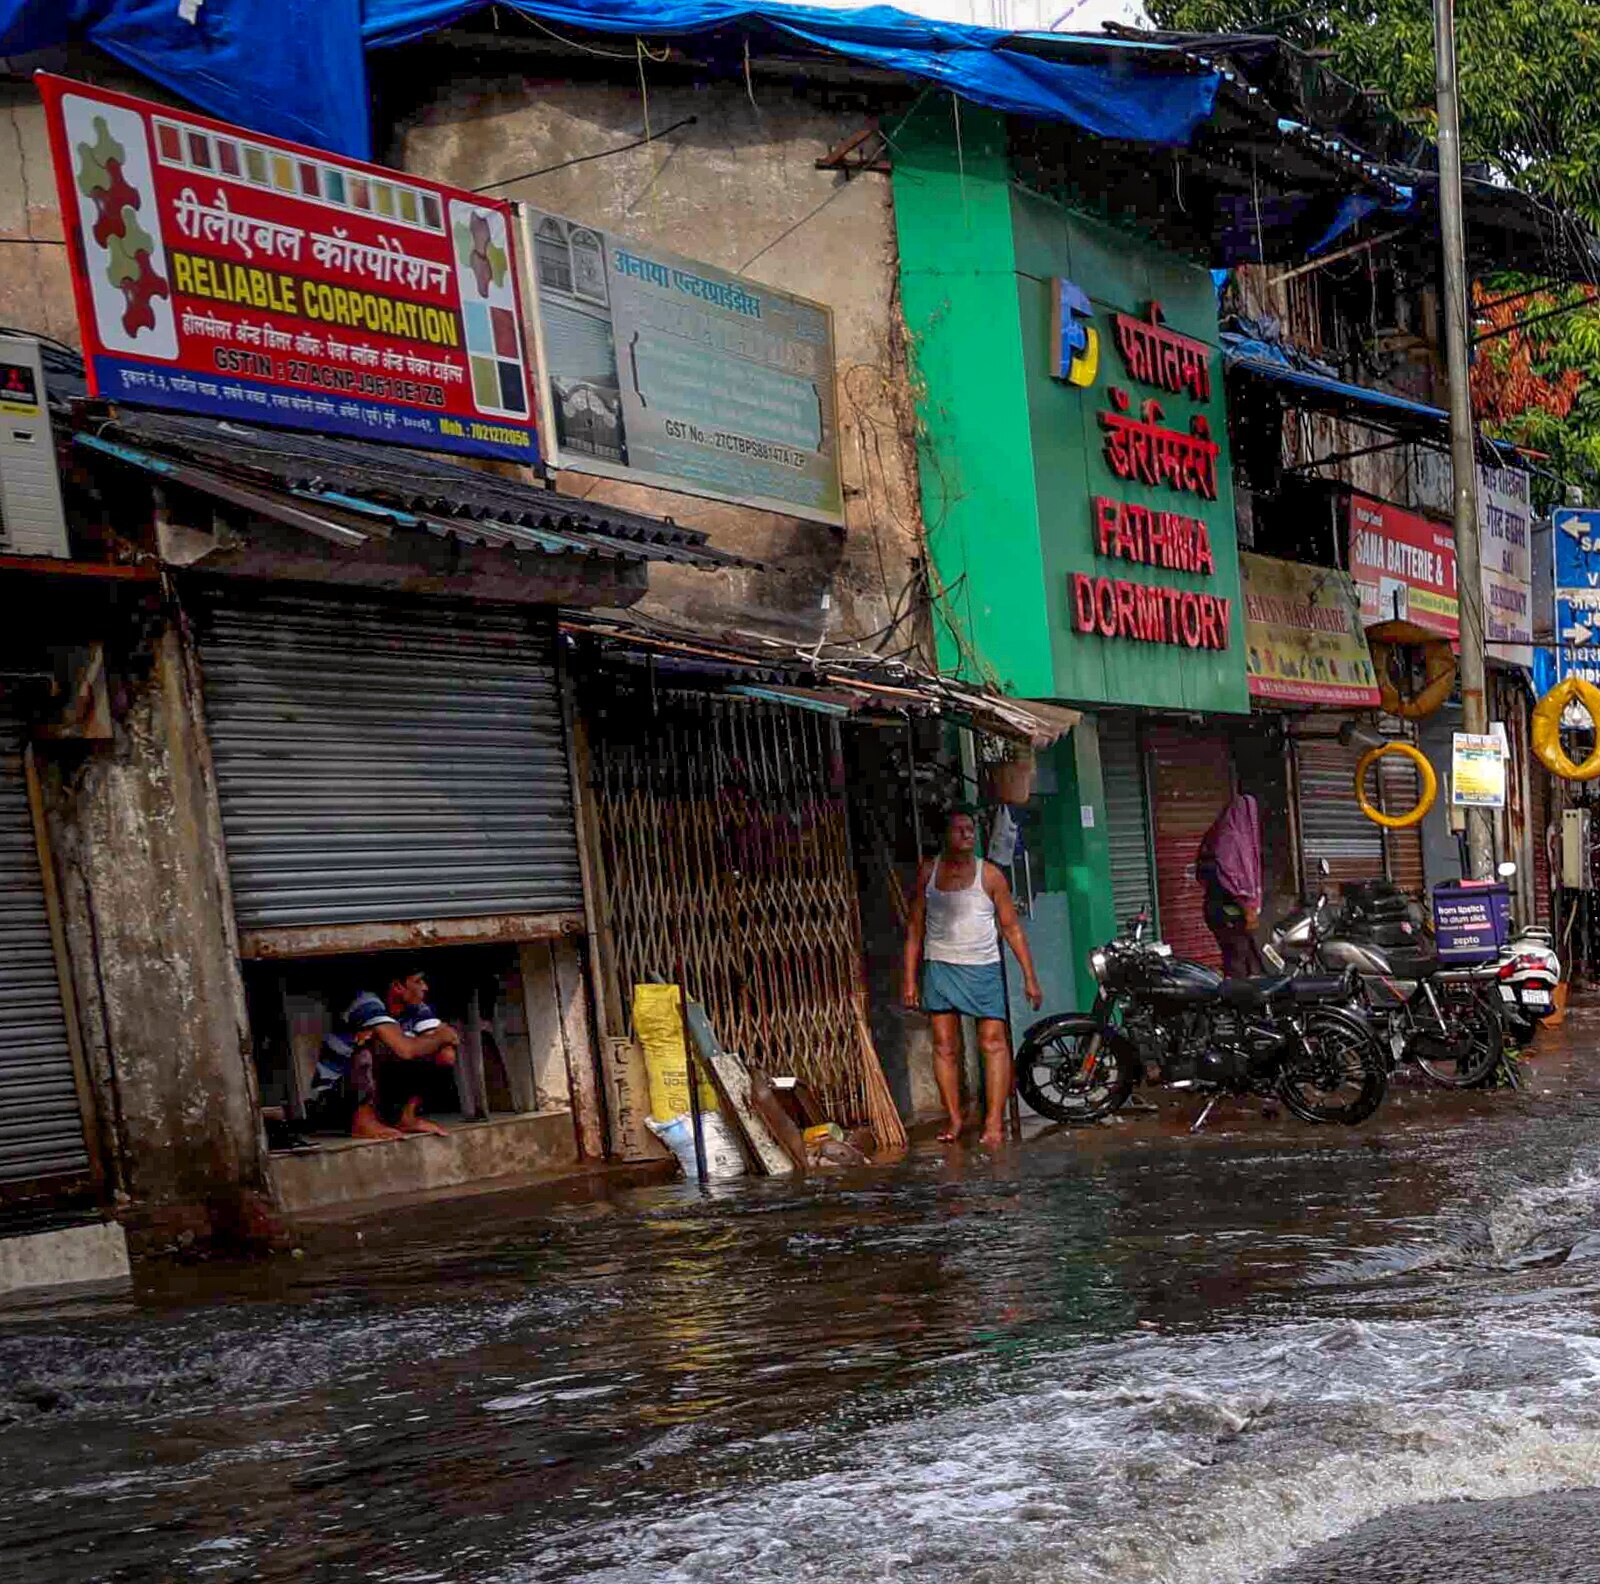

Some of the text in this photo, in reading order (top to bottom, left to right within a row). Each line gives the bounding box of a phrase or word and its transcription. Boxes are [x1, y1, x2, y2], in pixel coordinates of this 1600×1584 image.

[311, 226, 452, 294] कॉरपोरेशन
[173, 253, 459, 346] RELIABLE CORPORATION
[213, 346, 274, 379] GSTIN
[665, 419, 687, 437] GST
[1093, 496, 1215, 574] FATHIMA
[1388, 538, 1434, 584] BATTERIE
[1070, 572, 1232, 650] DORMITORY
[1453, 936, 1480, 946] zepto
